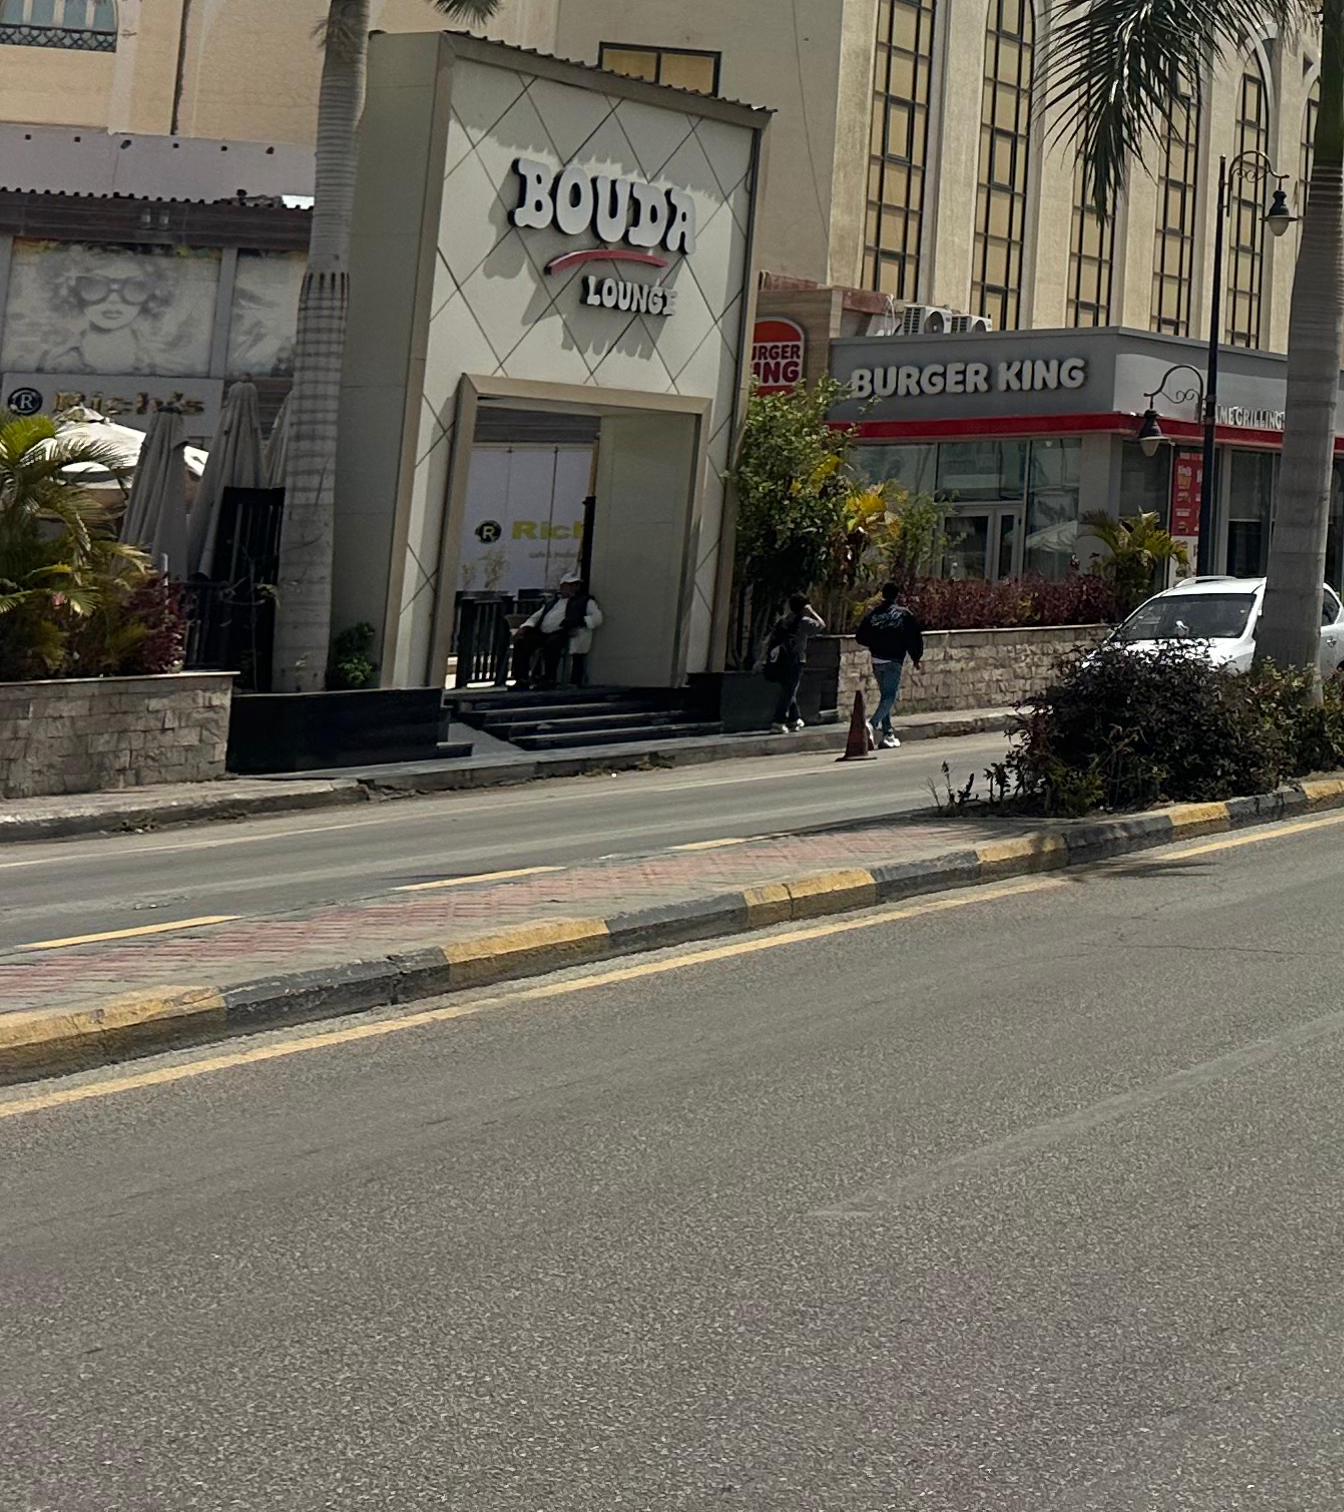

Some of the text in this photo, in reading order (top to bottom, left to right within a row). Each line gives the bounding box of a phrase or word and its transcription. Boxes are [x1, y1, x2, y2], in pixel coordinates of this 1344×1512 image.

[508, 157, 697, 255] BOUDA
[580, 275, 677, 317] LOUNGE
[752, 343, 800, 361] RGER
[850, 356, 1086, 399] BURGER KING
